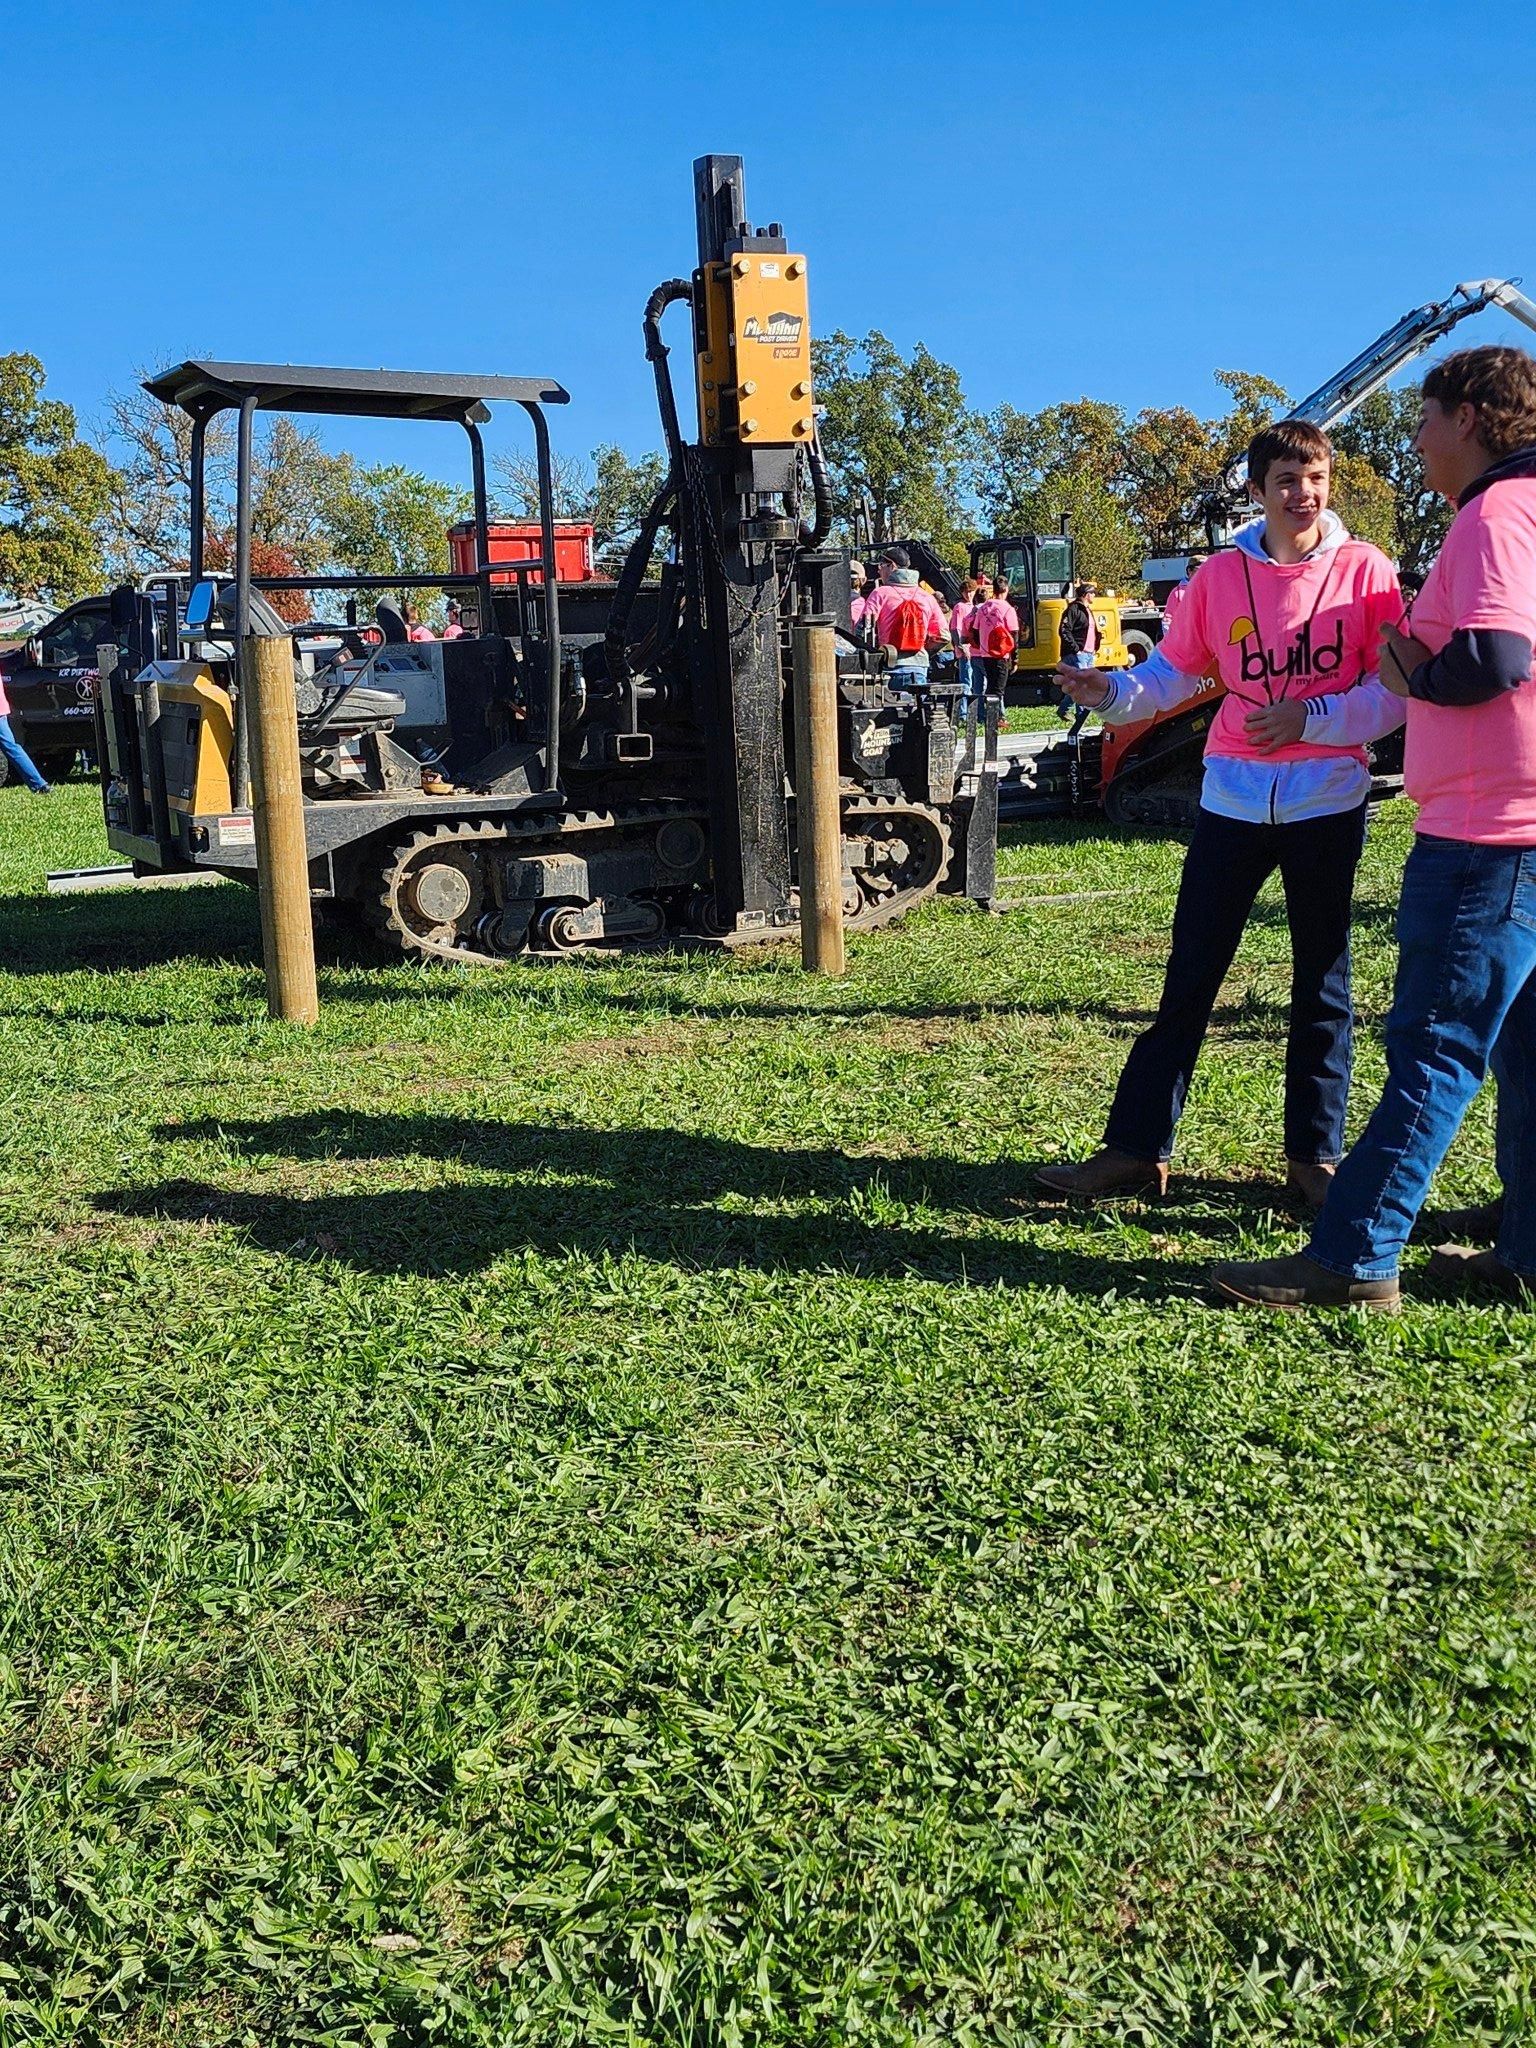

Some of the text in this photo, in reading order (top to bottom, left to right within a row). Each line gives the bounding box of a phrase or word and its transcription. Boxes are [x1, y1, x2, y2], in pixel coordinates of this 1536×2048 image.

[1241, 620, 1342, 681] build
[59, 668, 100, 677] KR DIRTWO
[863, 746, 884, 757] GOAT
